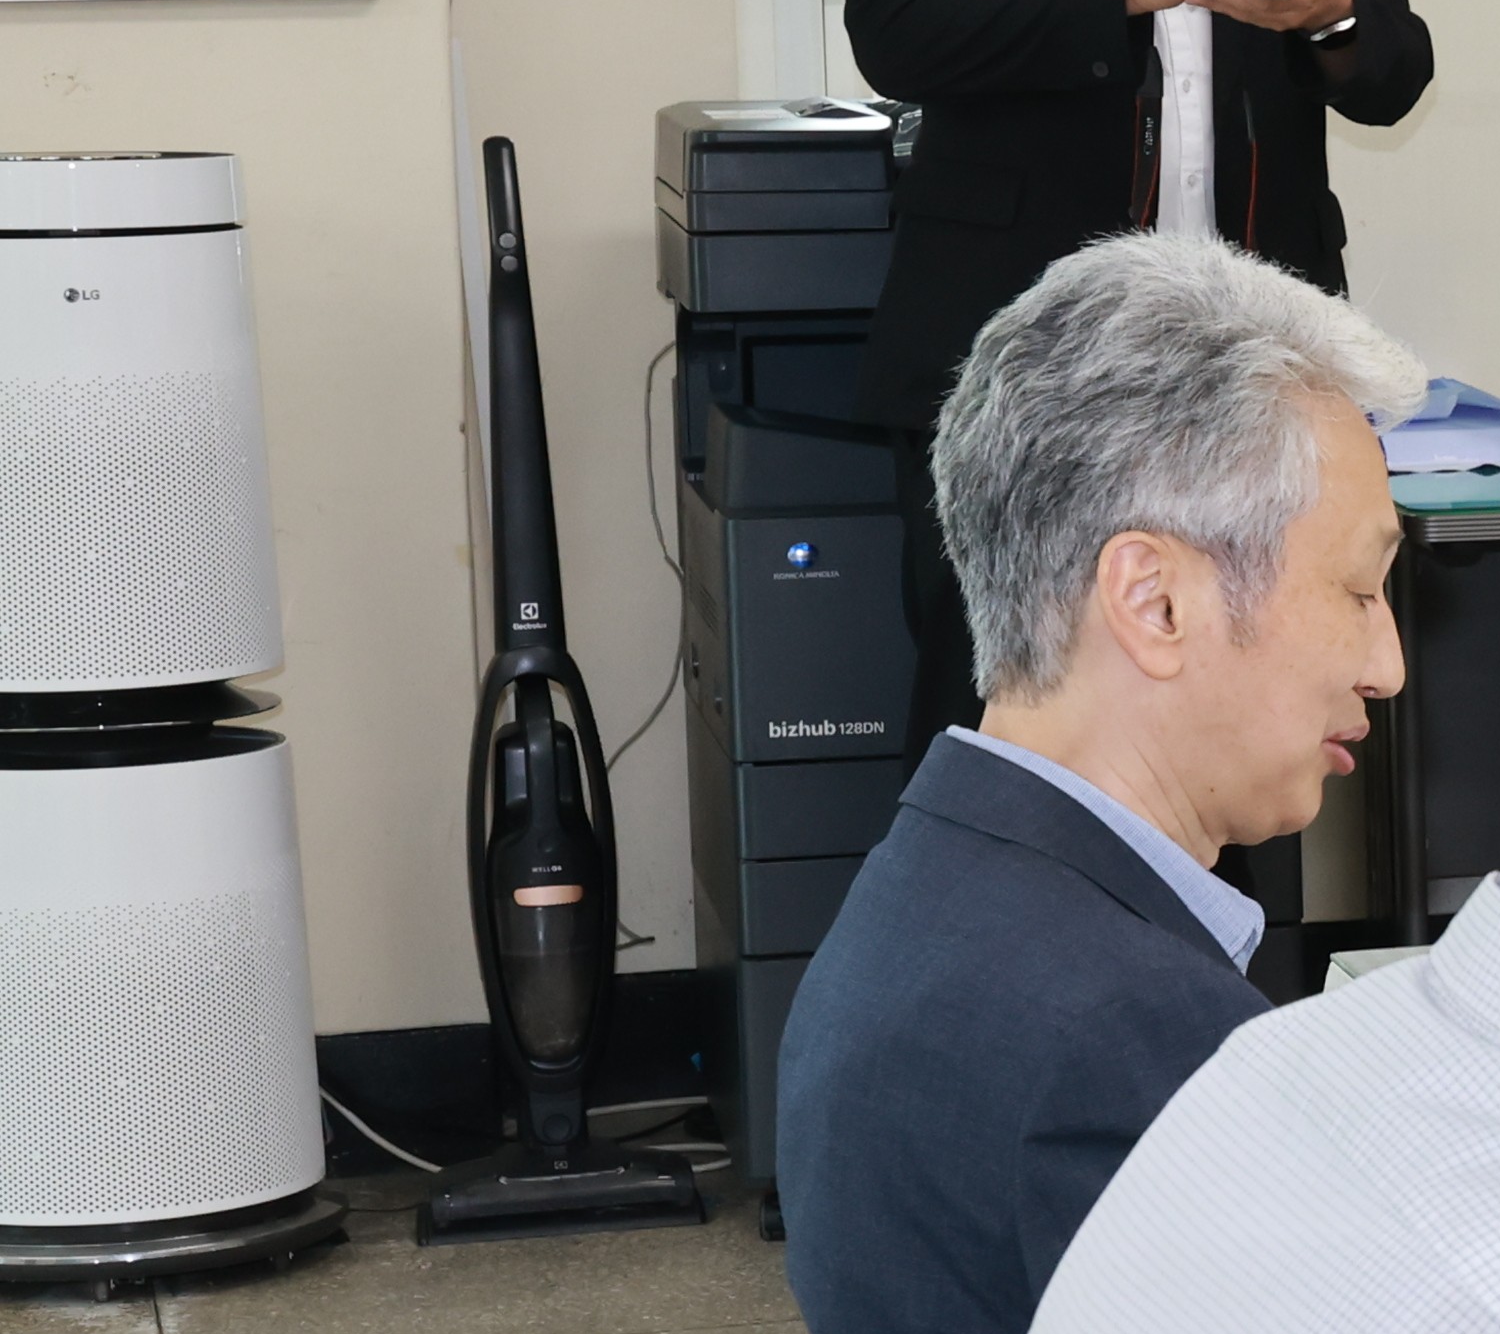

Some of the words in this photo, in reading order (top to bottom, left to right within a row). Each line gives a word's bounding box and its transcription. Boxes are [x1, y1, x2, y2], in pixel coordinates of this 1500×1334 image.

[82, 289, 101, 301] LG
[512, 622, 548, 631] Electrolux
[769, 720, 836, 738] bizhub
[839, 721, 885, 735] 128DN
